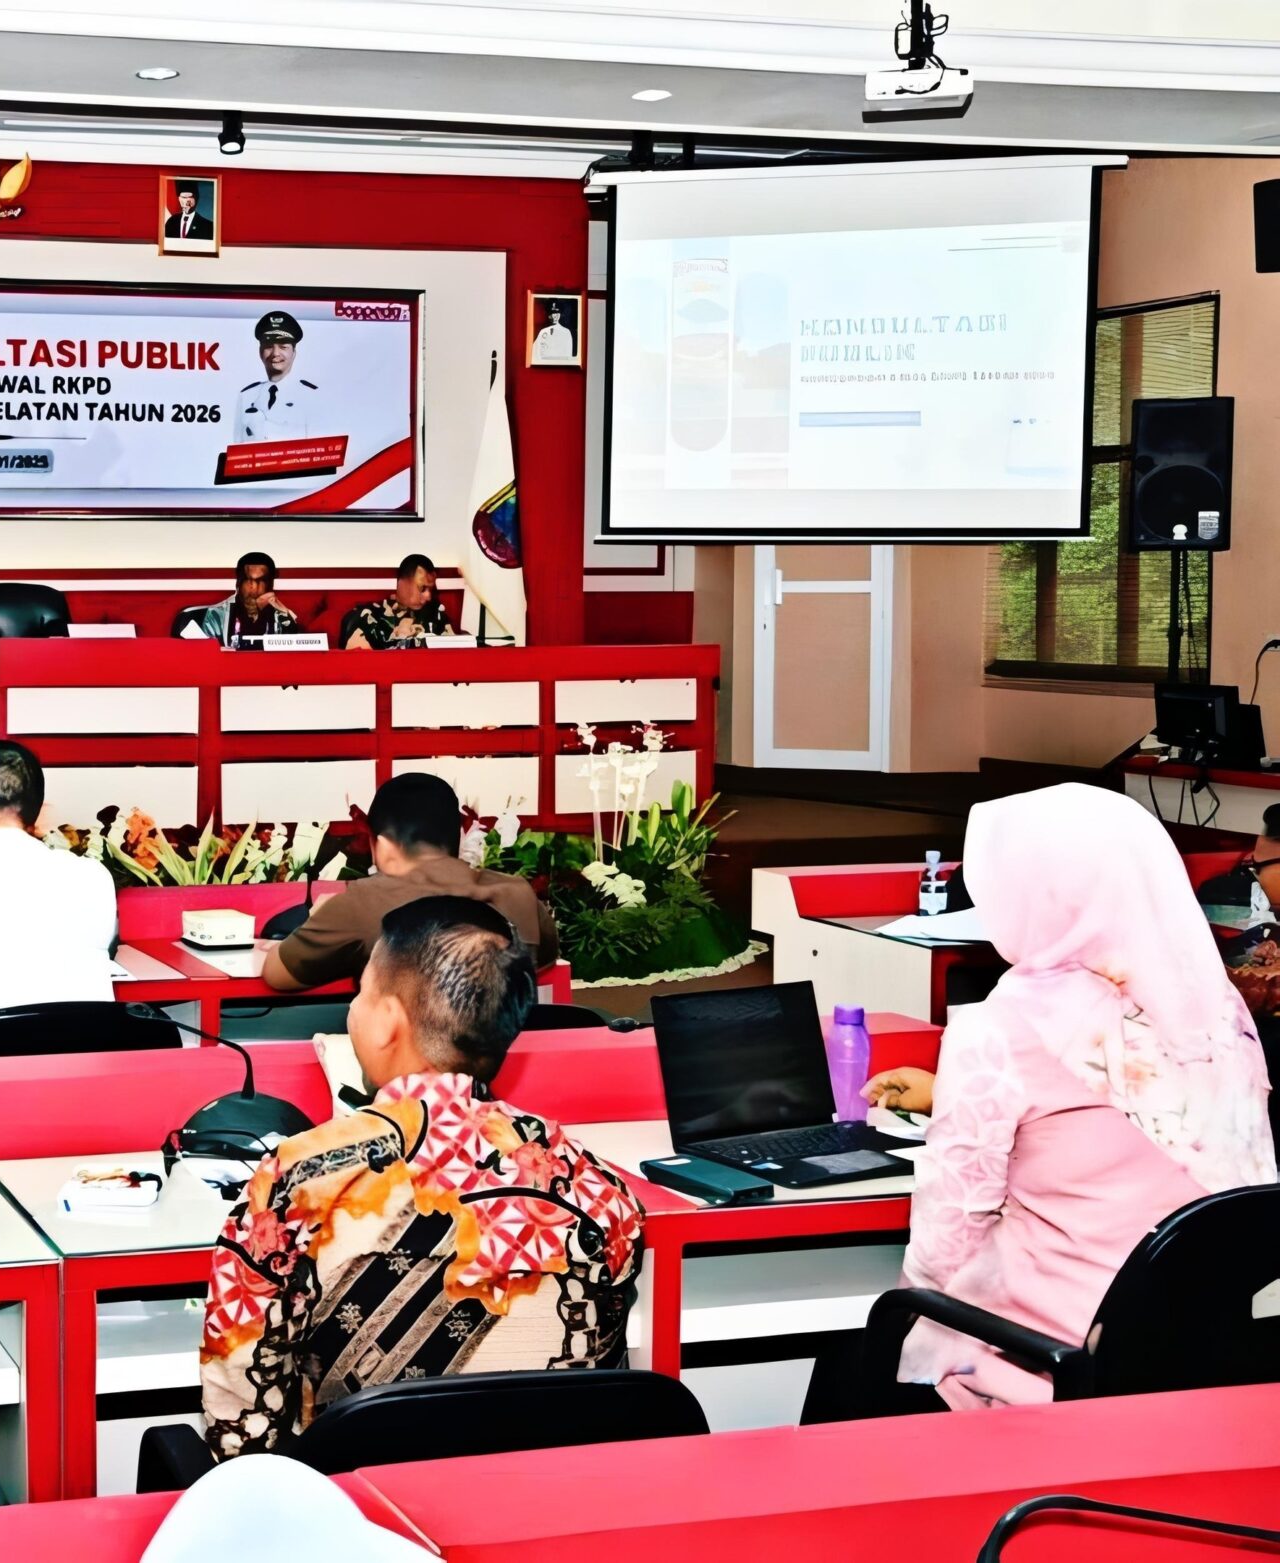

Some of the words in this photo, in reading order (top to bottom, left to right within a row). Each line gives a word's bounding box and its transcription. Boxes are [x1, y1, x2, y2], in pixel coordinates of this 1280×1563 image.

[97, 340, 221, 371] PUBLIK
[52, 376, 112, 396] RKPD
[85, 402, 165, 422] TAHUN
[171, 404, 222, 423] 2026
